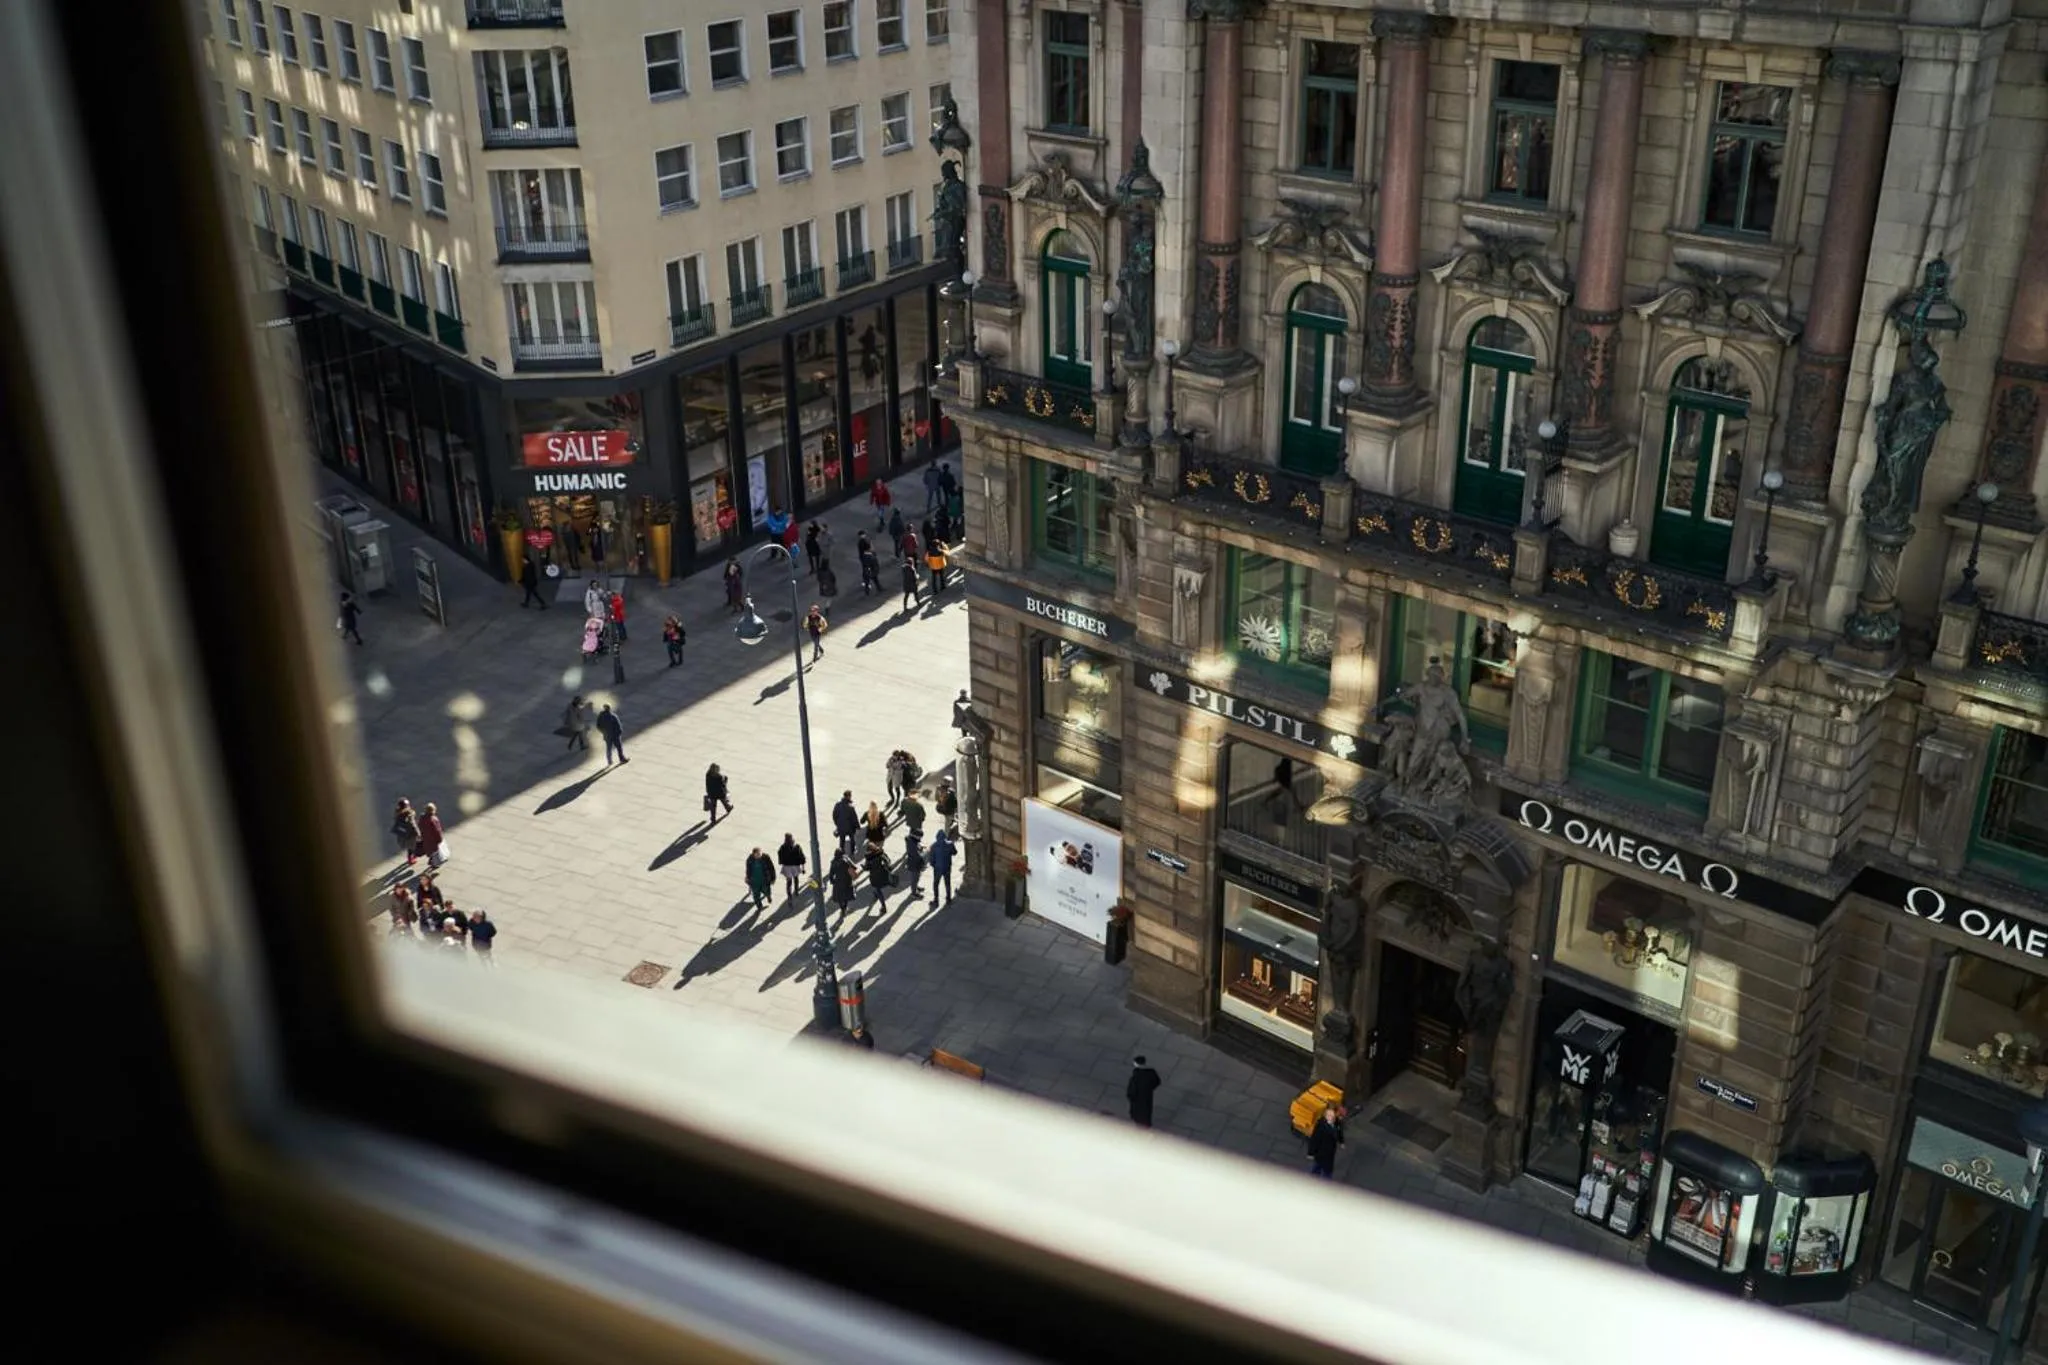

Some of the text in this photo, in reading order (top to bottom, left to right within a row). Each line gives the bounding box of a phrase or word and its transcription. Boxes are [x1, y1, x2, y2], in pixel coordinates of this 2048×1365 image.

[547, 435, 609, 462] SALE
[534, 472, 627, 492] HUMANIC
[1026, 596, 1108, 636] BUCHERER
[1187, 682, 1317, 746] PILSTL
[1564, 819, 1687, 882] OMEGA
[1959, 909, 2048, 958] OME
[1561, 1044, 1592, 1084] WMF
[1942, 1163, 2016, 1203] OMEGA
